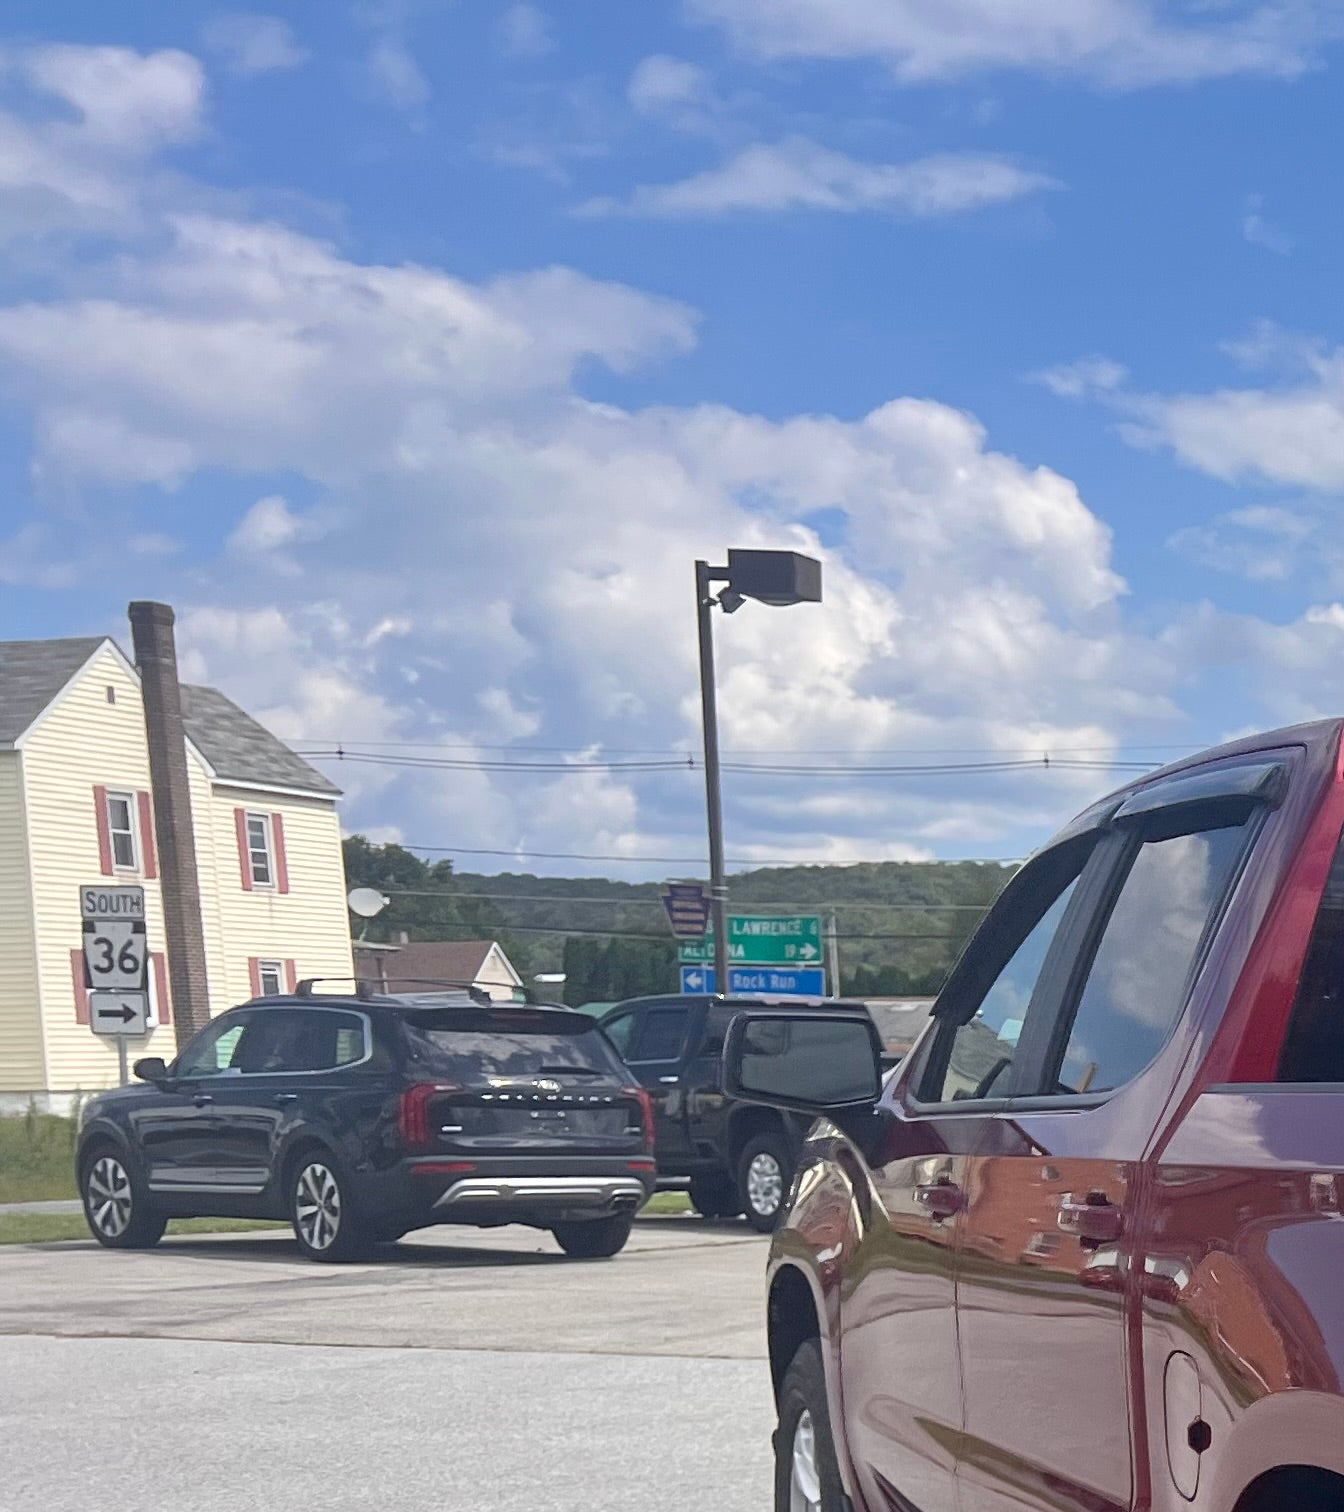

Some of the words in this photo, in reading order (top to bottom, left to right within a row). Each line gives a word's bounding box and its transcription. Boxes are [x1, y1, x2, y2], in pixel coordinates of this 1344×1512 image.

[85, 891, 141, 913] SOUTH
[732, 919, 803, 936] LAWRENCE
[93, 936, 139, 974] 36
[683, 943, 745, 958] ALTONA
[733, 973, 766, 989] Rock
[771, 974, 796, 989] Run
